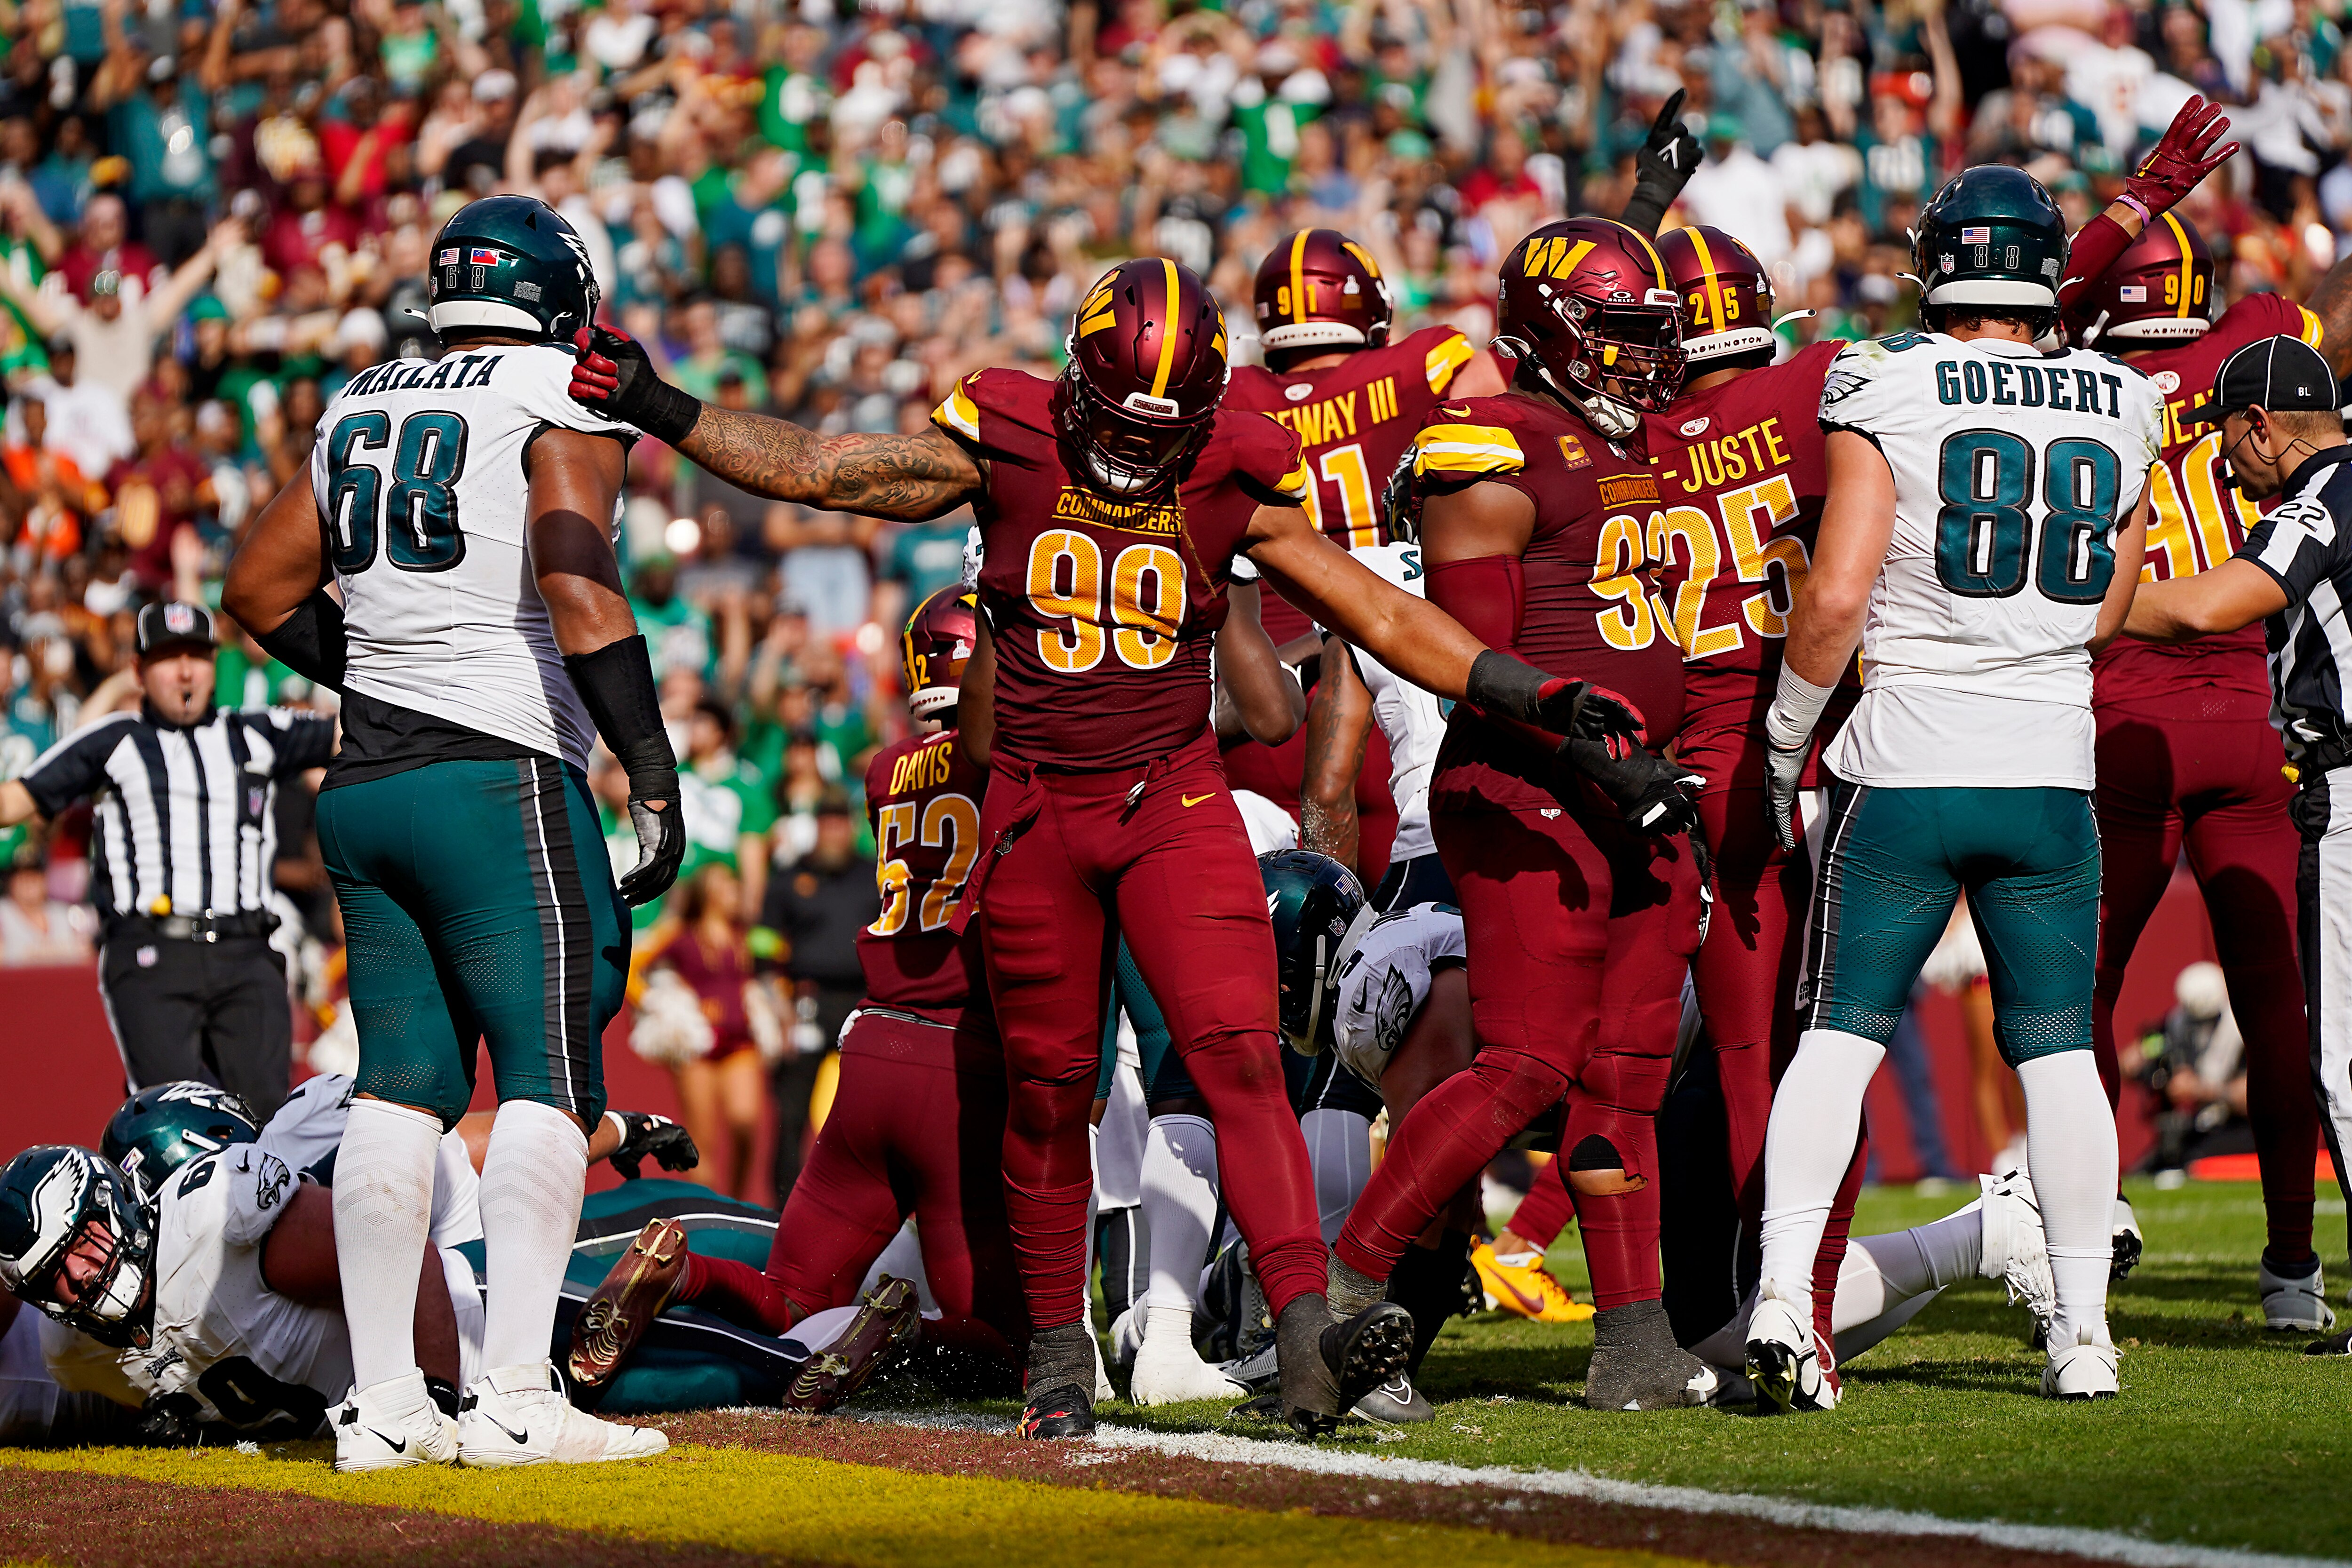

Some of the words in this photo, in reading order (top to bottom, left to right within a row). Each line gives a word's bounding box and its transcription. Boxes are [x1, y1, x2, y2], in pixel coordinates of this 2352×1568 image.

[1524, 237, 1597, 280] W
[1943, 262, 1953, 271] NFL
[1691, 336, 1763, 355] ASHINGTON
[342, 355, 506, 399] MAILATA
[1935, 360, 2123, 419] GOEDERT
[2297, 387, 2311, 397] BL
[1367, 376, 1399, 424] III
[1559, 435, 1585, 462] C
[327, 409, 469, 576] 68
[1056, 492, 1182, 533] COMMANDERS
[1599, 479, 1659, 505] COMMANDERS
[1934, 428, 2122, 605] 88
[2274, 502, 2326, 533] 22
[1666, 473, 1812, 662] 25
[1026, 528, 1187, 673] 99
[889, 741, 953, 796] DAVIS
[866, 793, 980, 936] 52
[1334, 922, 1346, 934] NFL
